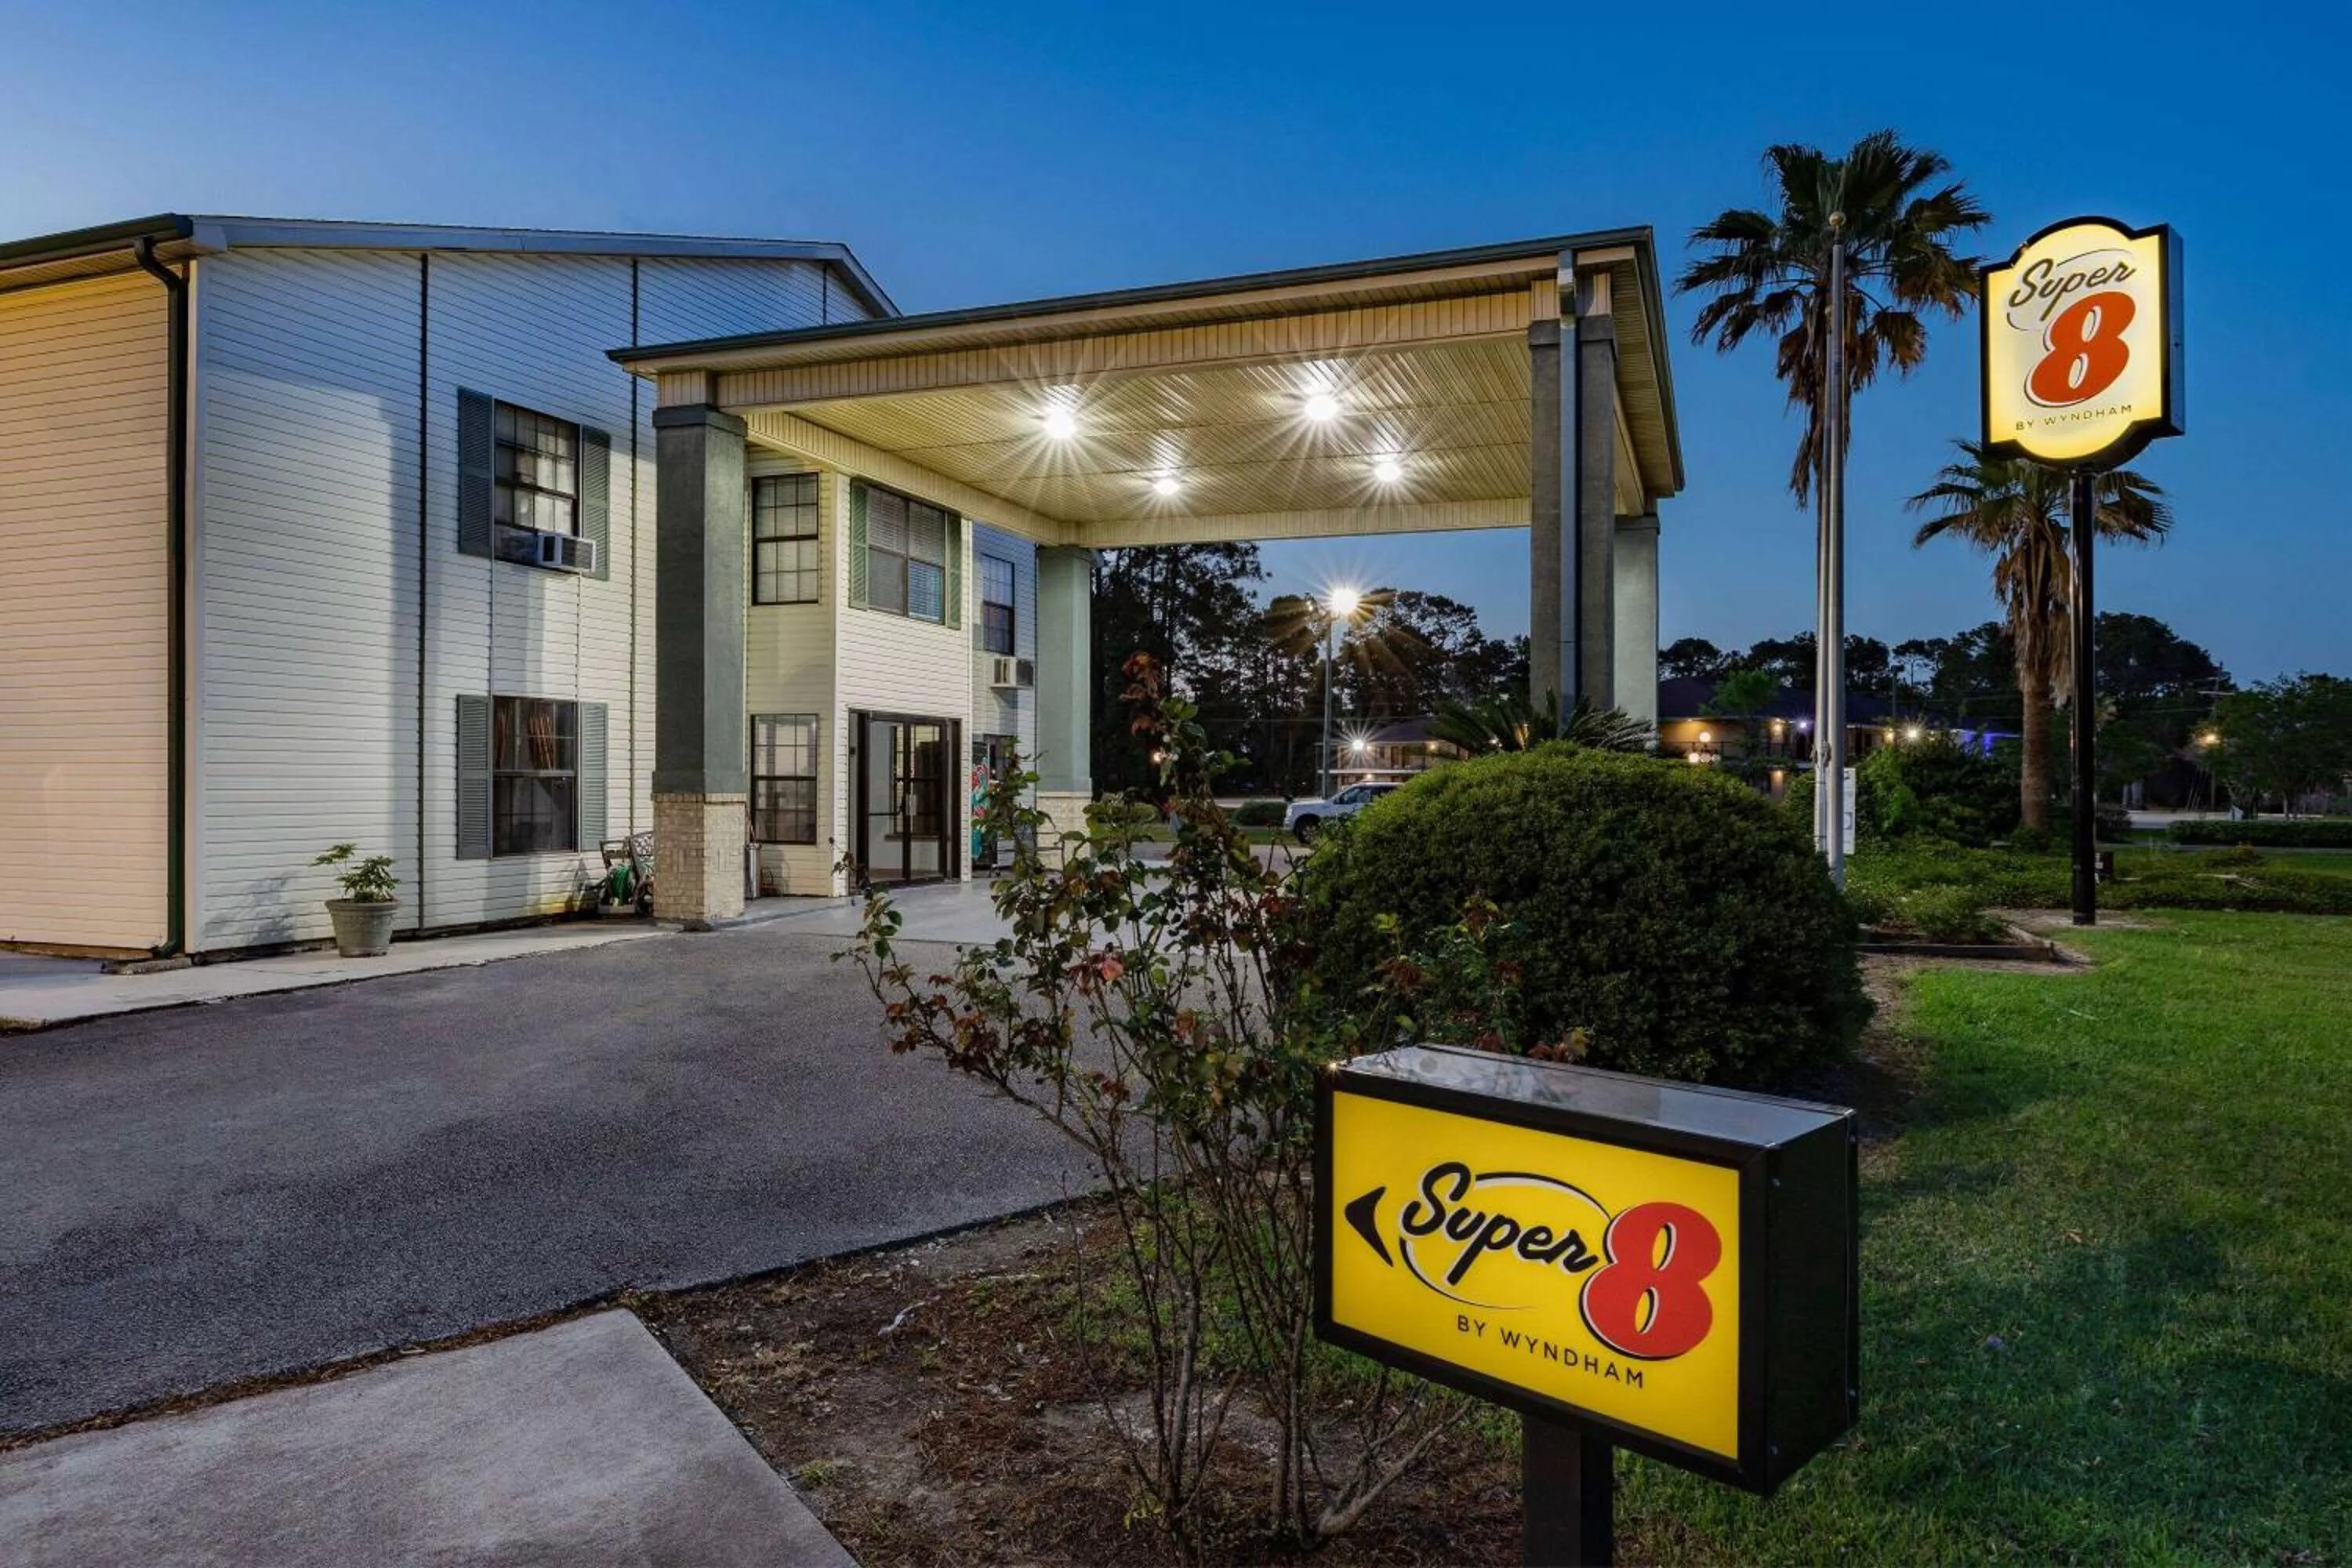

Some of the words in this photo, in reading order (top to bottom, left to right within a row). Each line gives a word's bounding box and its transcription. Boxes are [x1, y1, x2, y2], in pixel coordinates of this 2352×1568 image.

[2009, 258, 2136, 322] Super
[2024, 291, 2136, 408] 8
[2016, 420, 2034, 430] BY
[2044, 405, 2132, 425] WYNDHAM
[1402, 1162, 1599, 1286] Super
[1579, 1202, 1722, 1361] 8
[1457, 1315, 1485, 1336] BY
[1501, 1327, 1643, 1388] WYNDHAM
